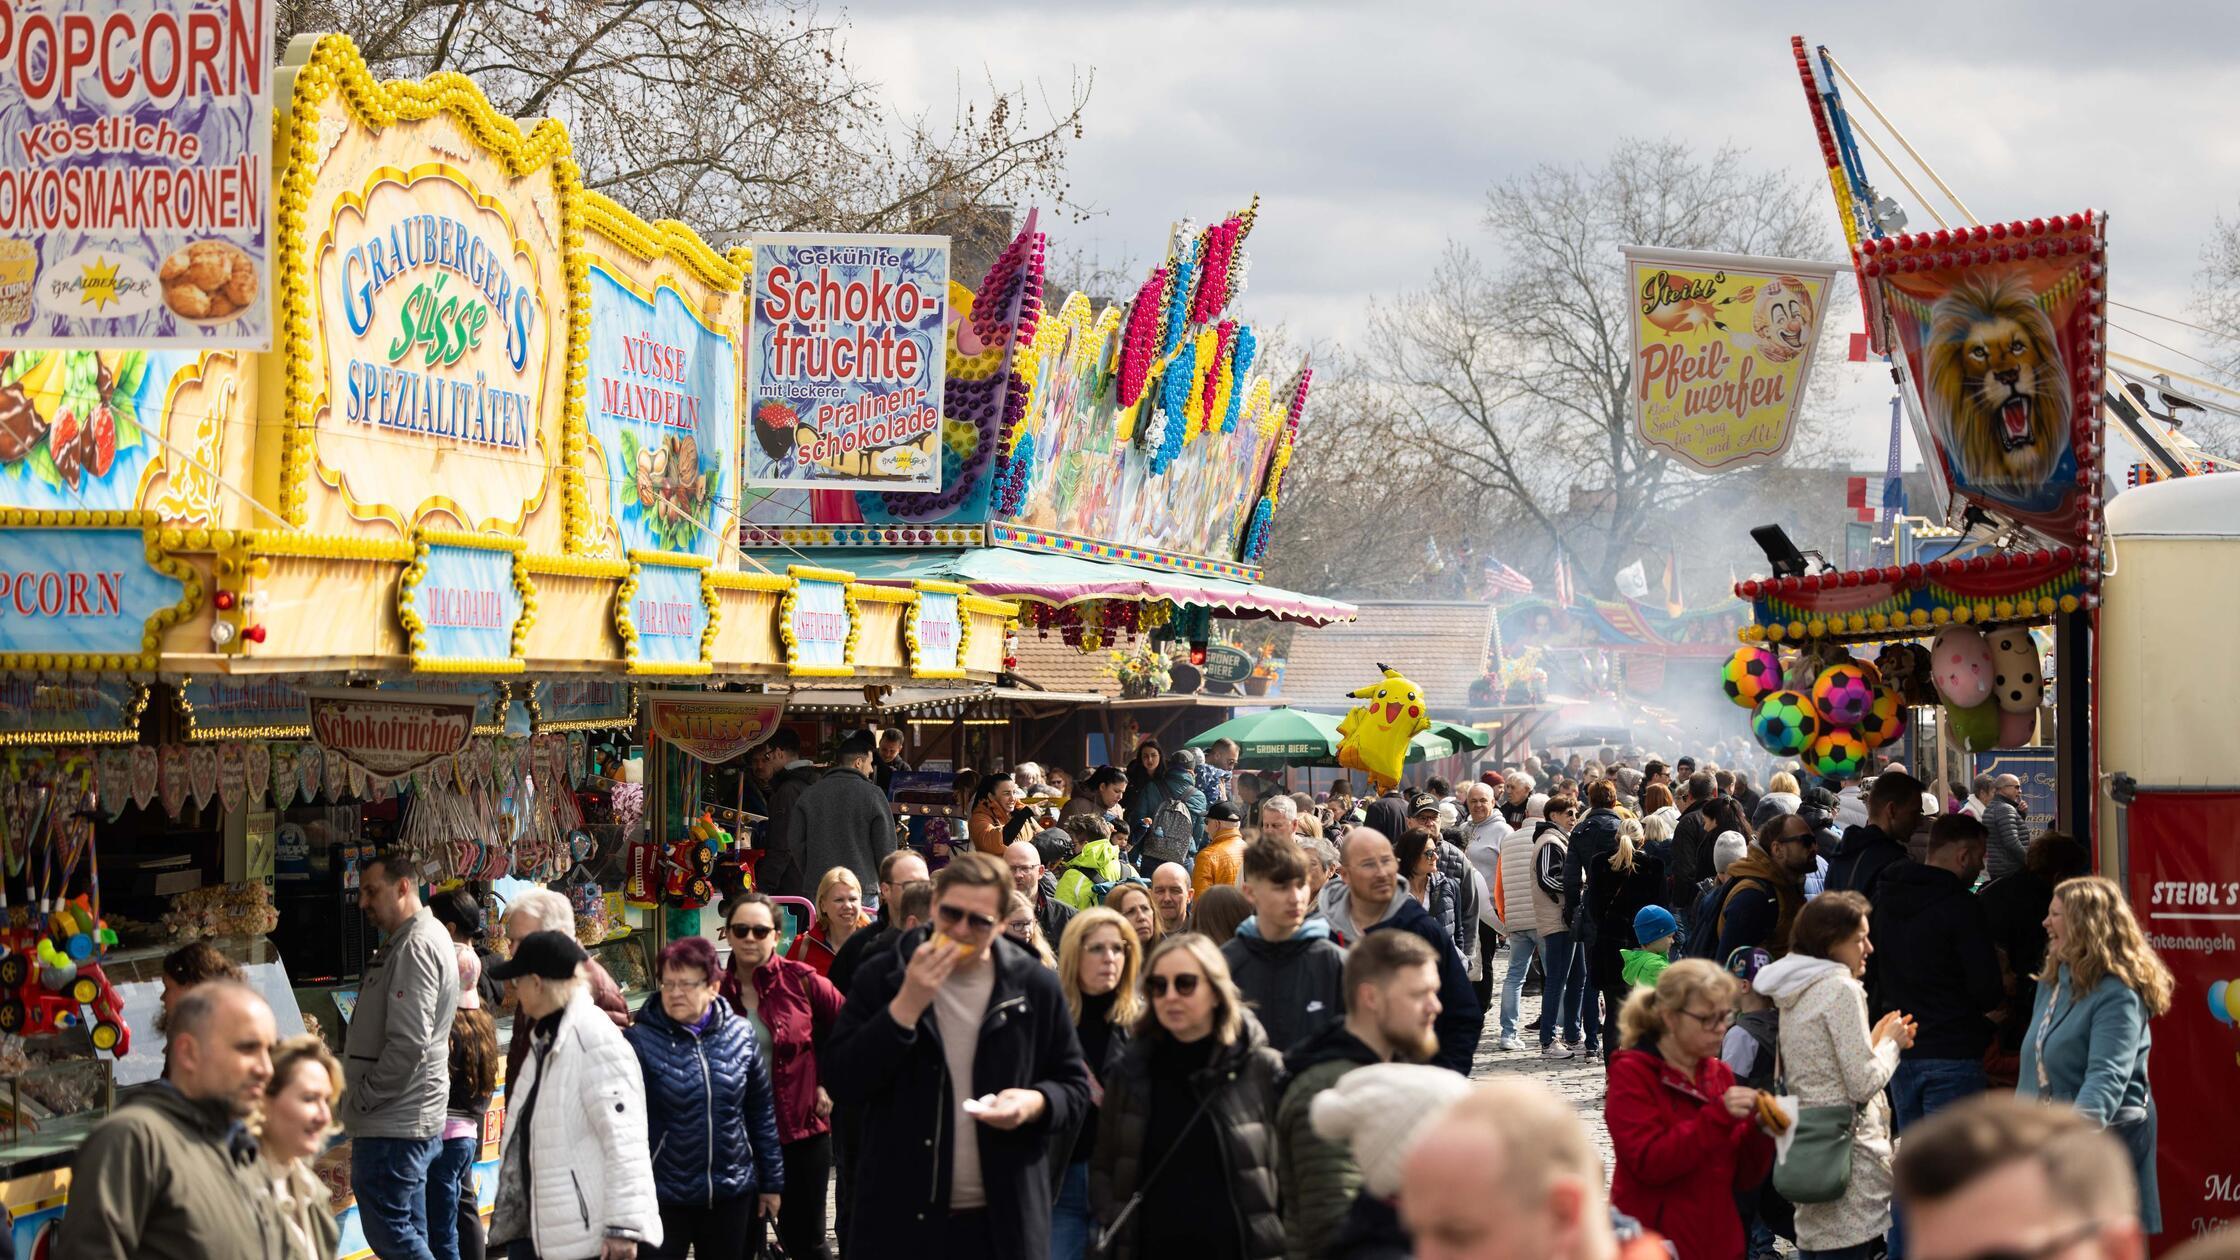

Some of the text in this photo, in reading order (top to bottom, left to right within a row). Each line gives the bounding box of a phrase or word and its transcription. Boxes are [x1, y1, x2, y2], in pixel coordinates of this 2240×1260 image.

[20, 117, 199, 163] Köstliche
[797, 249, 900, 268] Gekühlte
[341, 213, 535, 372] GRAUBERGERS
[764, 266, 936, 323] Schoko-
[621, 331, 686, 384] NÜSSE
[772, 314, 918, 379] früchte
[760, 384, 847, 399] mit leckerer
[1640, 340, 1730, 401] Pfeil-
[1684, 355, 1784, 418] werfen
[346, 358, 530, 449] SPEZIALITÄTEN
[601, 376, 700, 430] MANDELN
[818, 385, 926, 432] Pralinen-
[798, 404, 937, 466] schokolade
[1674, 430, 1692, 450] für
[1706, 418, 1781, 456] und Alt!
[426, 587, 502, 627] MACADAMIA
[639, 595, 693, 635] PARANÜSSE
[1208, 664, 1233, 677] BIERE
[319, 712, 462, 753] Schokofrüchte
[1288, 743, 1309, 753] BIERE
[2144, 931, 2236, 955] Entenangeln
